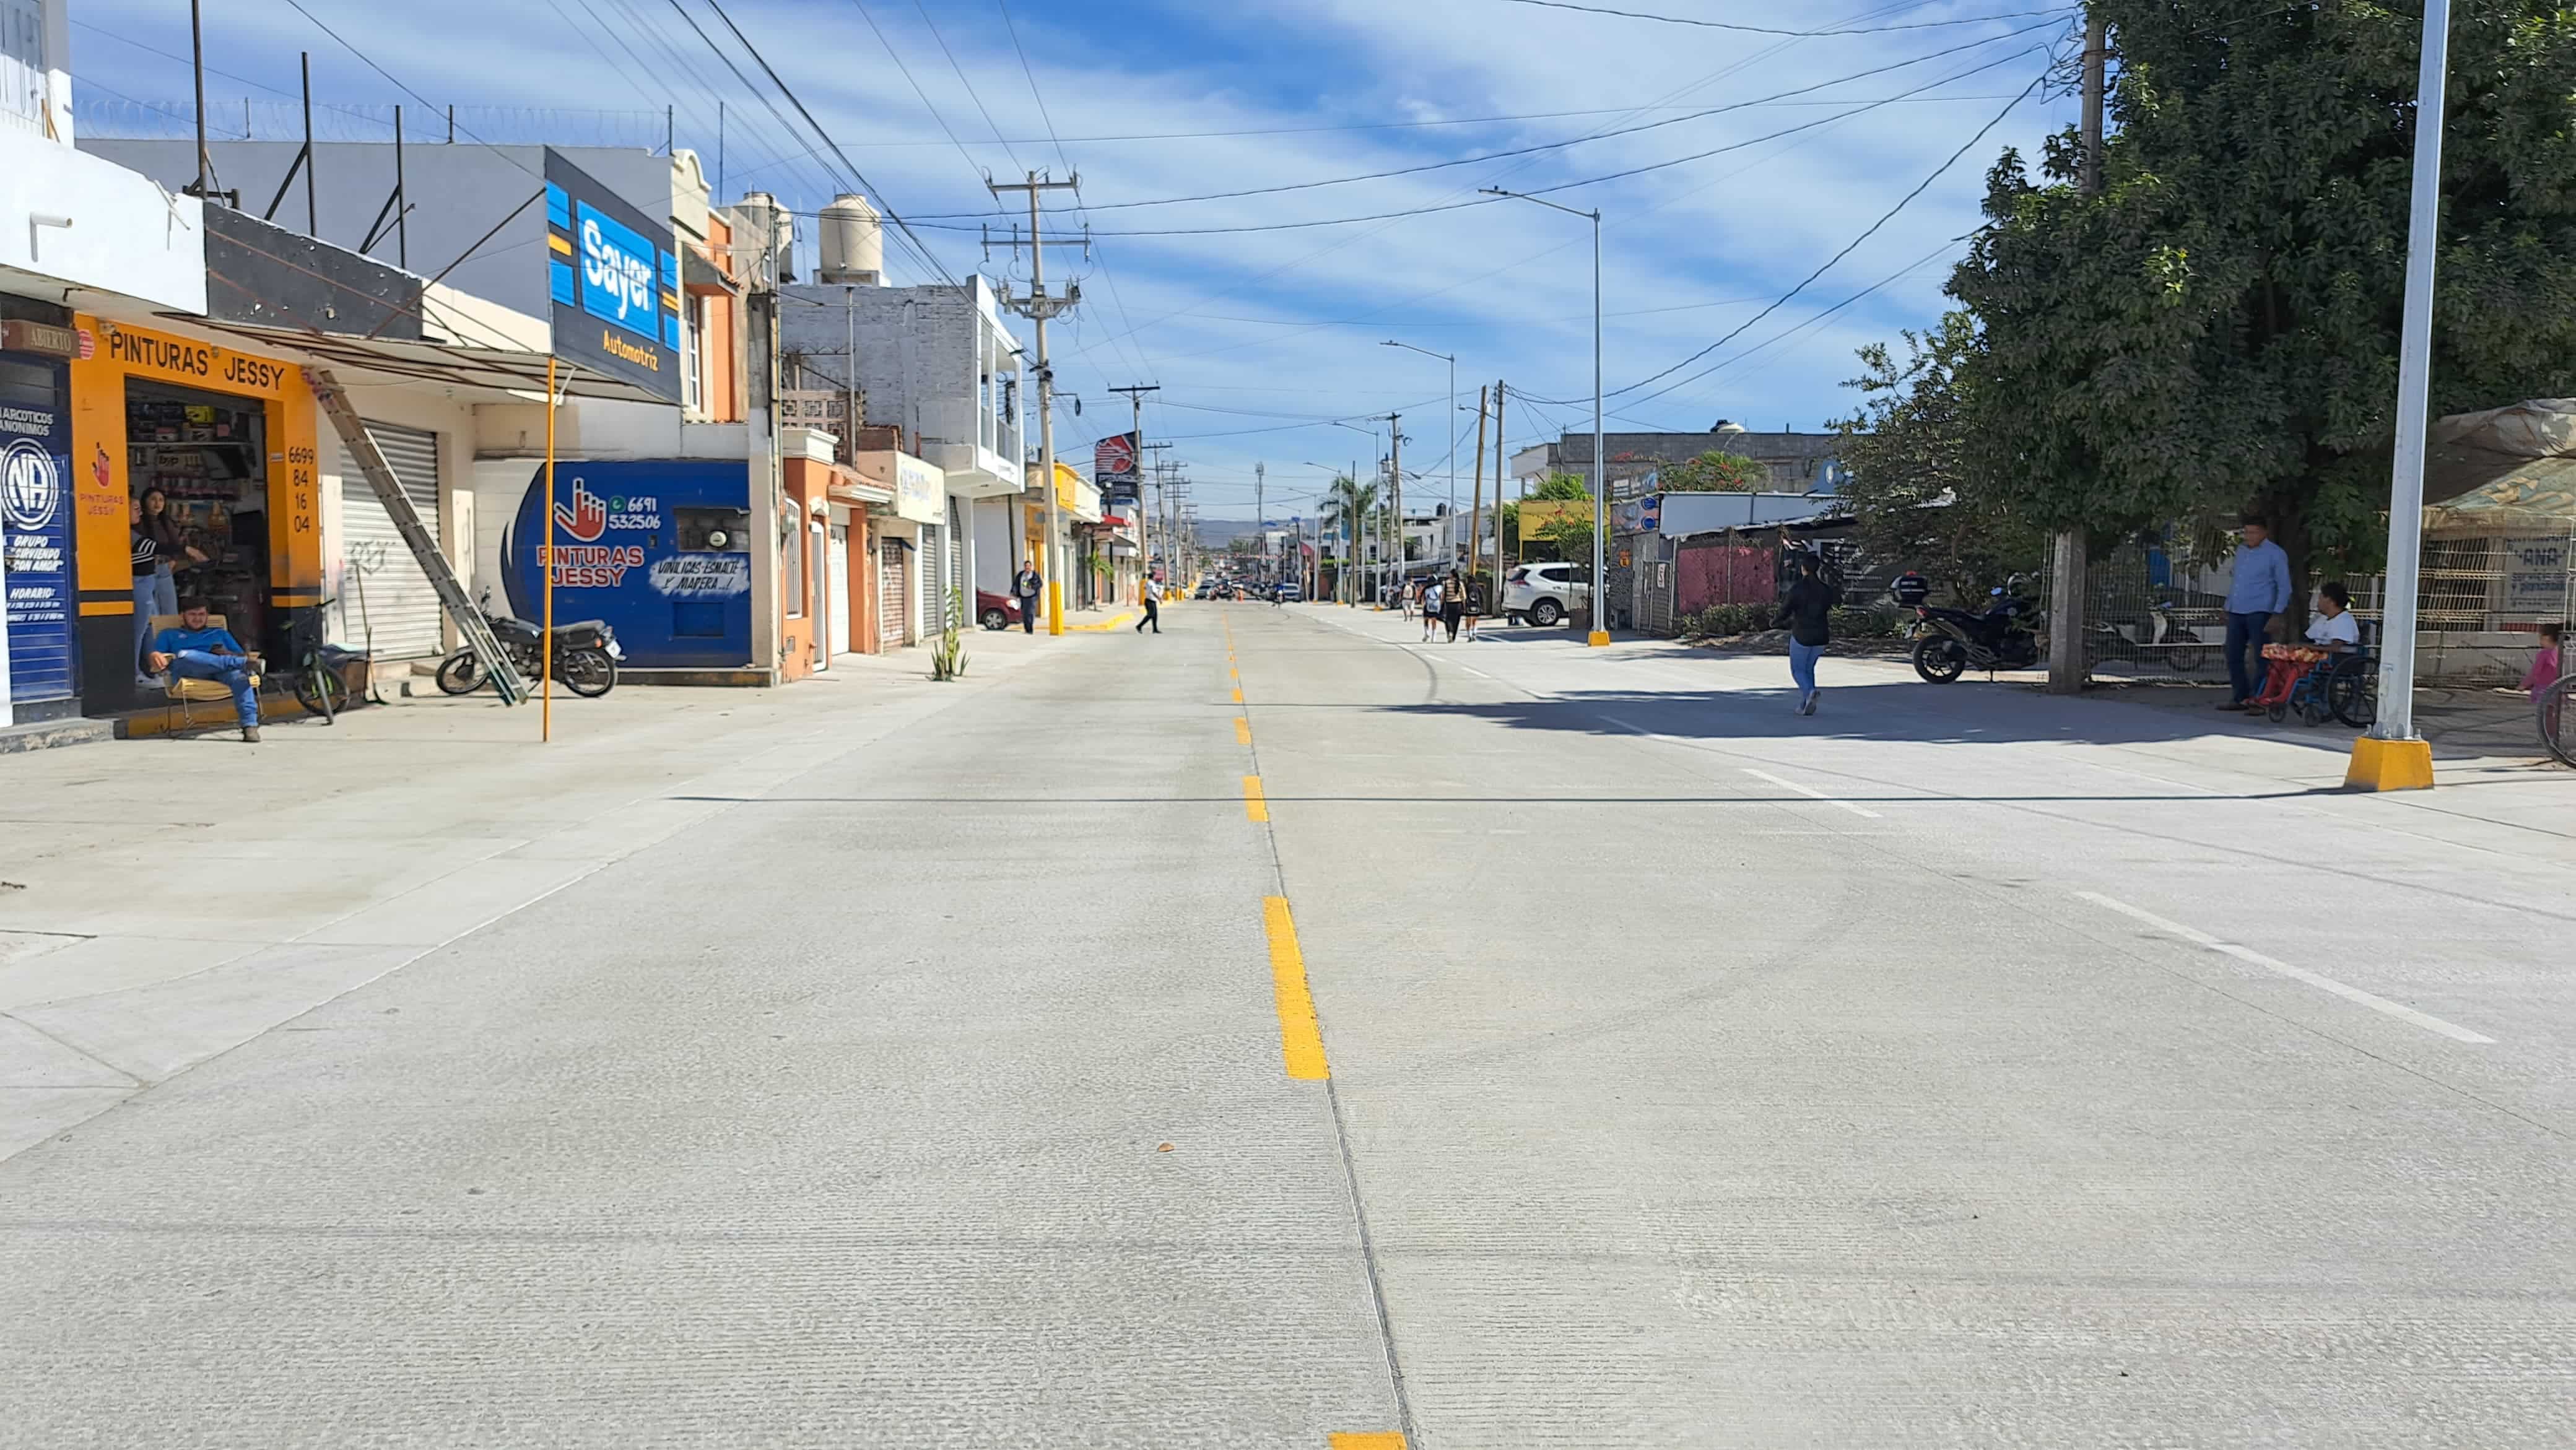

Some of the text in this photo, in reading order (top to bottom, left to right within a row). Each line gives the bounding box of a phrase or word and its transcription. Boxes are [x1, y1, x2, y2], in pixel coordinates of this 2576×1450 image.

[583, 219, 651, 321] Sayer
[31, 326, 71, 352] ABIERTO
[110, 332, 285, 391] PINTURAS JESSY
[289, 446, 314, 465] 6699
[8, 453, 48, 515] NA
[294, 469, 308, 487] 84
[295, 492, 307, 510] 16
[627, 497, 656, 513] 6691
[294, 515, 310, 533] 04
[608, 514, 661, 529] 532506
[14, 535, 48, 548] GRUPO
[551, 566, 627, 588] JESSY
